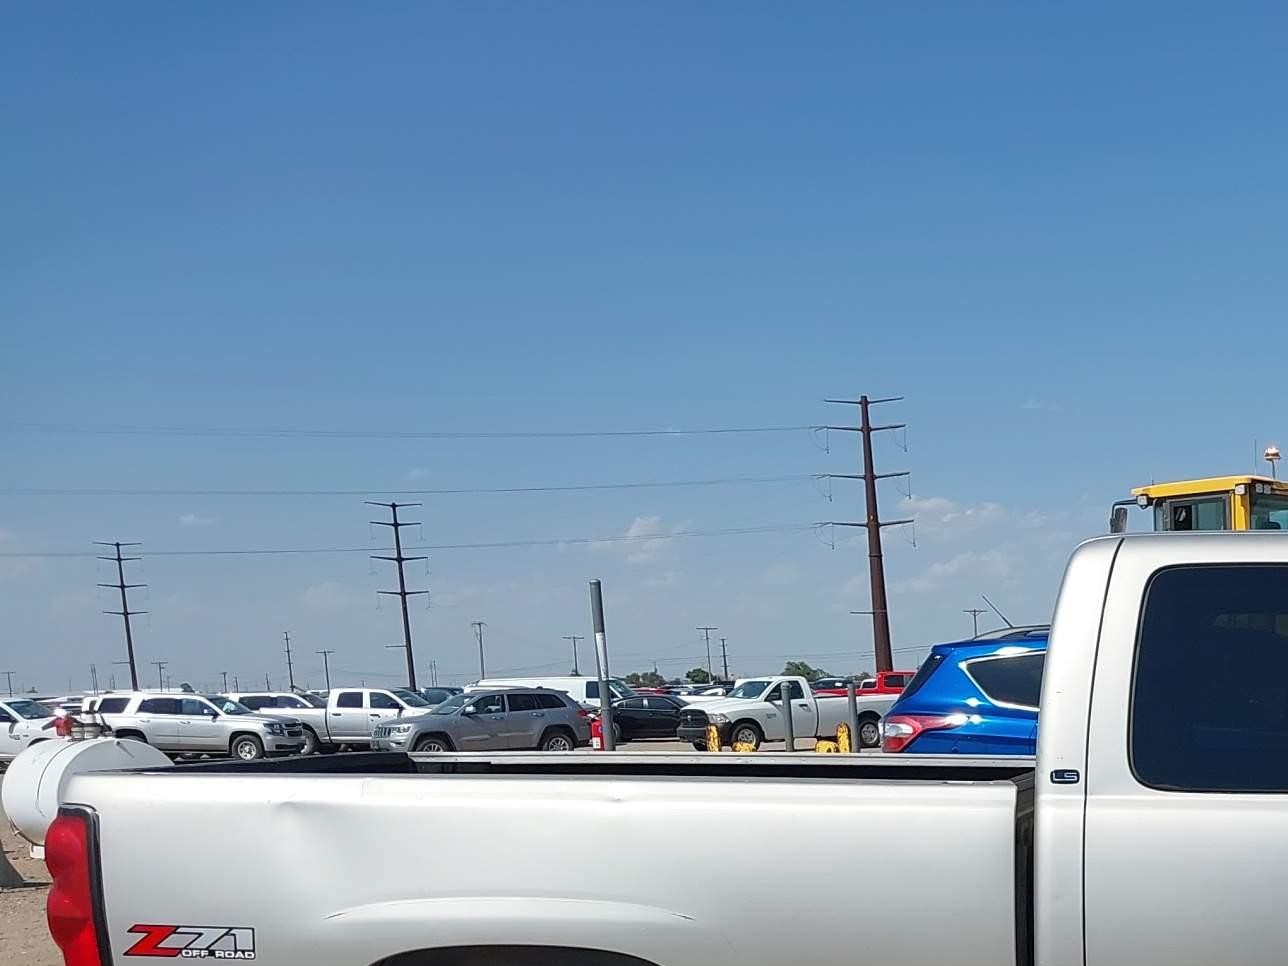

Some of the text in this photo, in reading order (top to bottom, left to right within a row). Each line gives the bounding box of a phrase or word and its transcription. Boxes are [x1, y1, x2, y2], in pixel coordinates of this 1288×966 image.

[1052, 772, 1077, 781] LS
[122, 923, 256, 958] Z71
[181, 950, 255, 959] OFF ROAD
